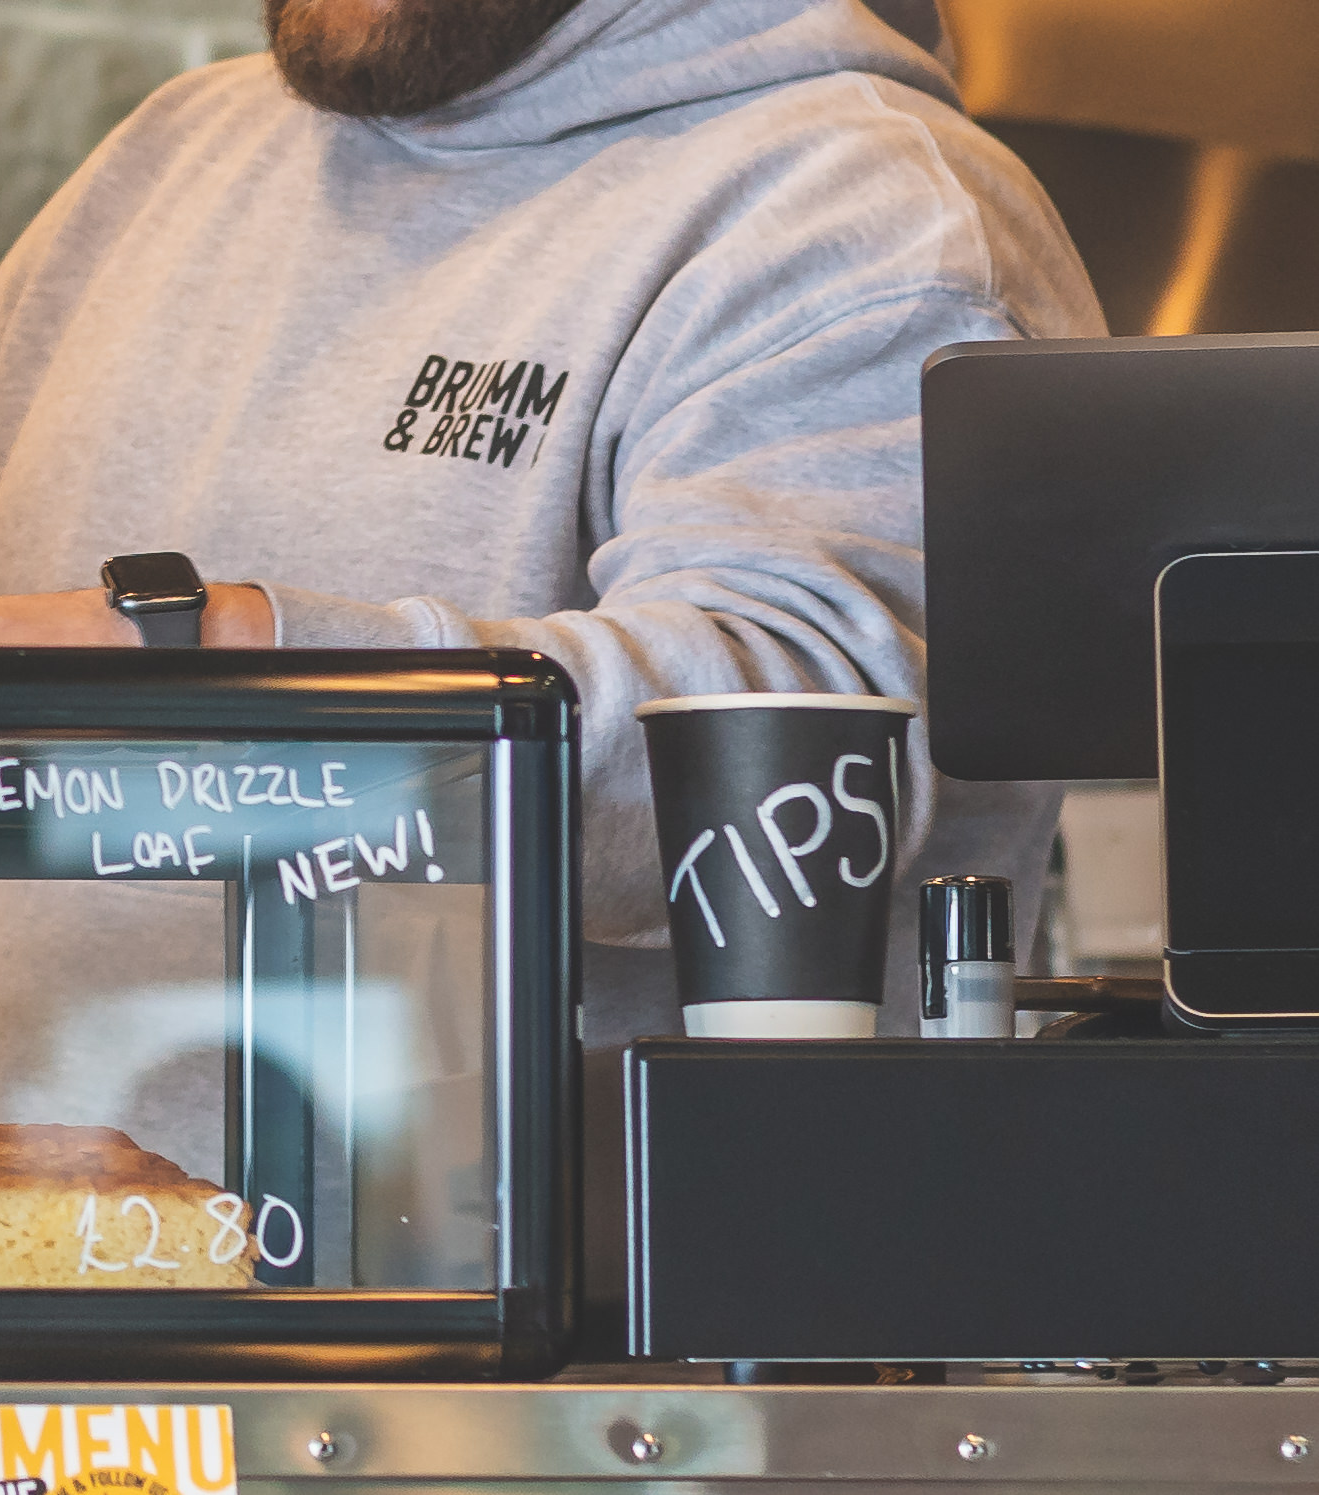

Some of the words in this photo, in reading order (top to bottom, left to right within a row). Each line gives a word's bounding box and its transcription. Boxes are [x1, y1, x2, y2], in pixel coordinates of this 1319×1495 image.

[384, 408, 419, 452] &
[421, 414, 530, 468] BREW
[157, 760, 355, 813] DRIZZLE
[92, 825, 216, 876] LOAF
[277, 808, 443, 905] NEW!
[75, 1191, 304, 1274] £2.80
